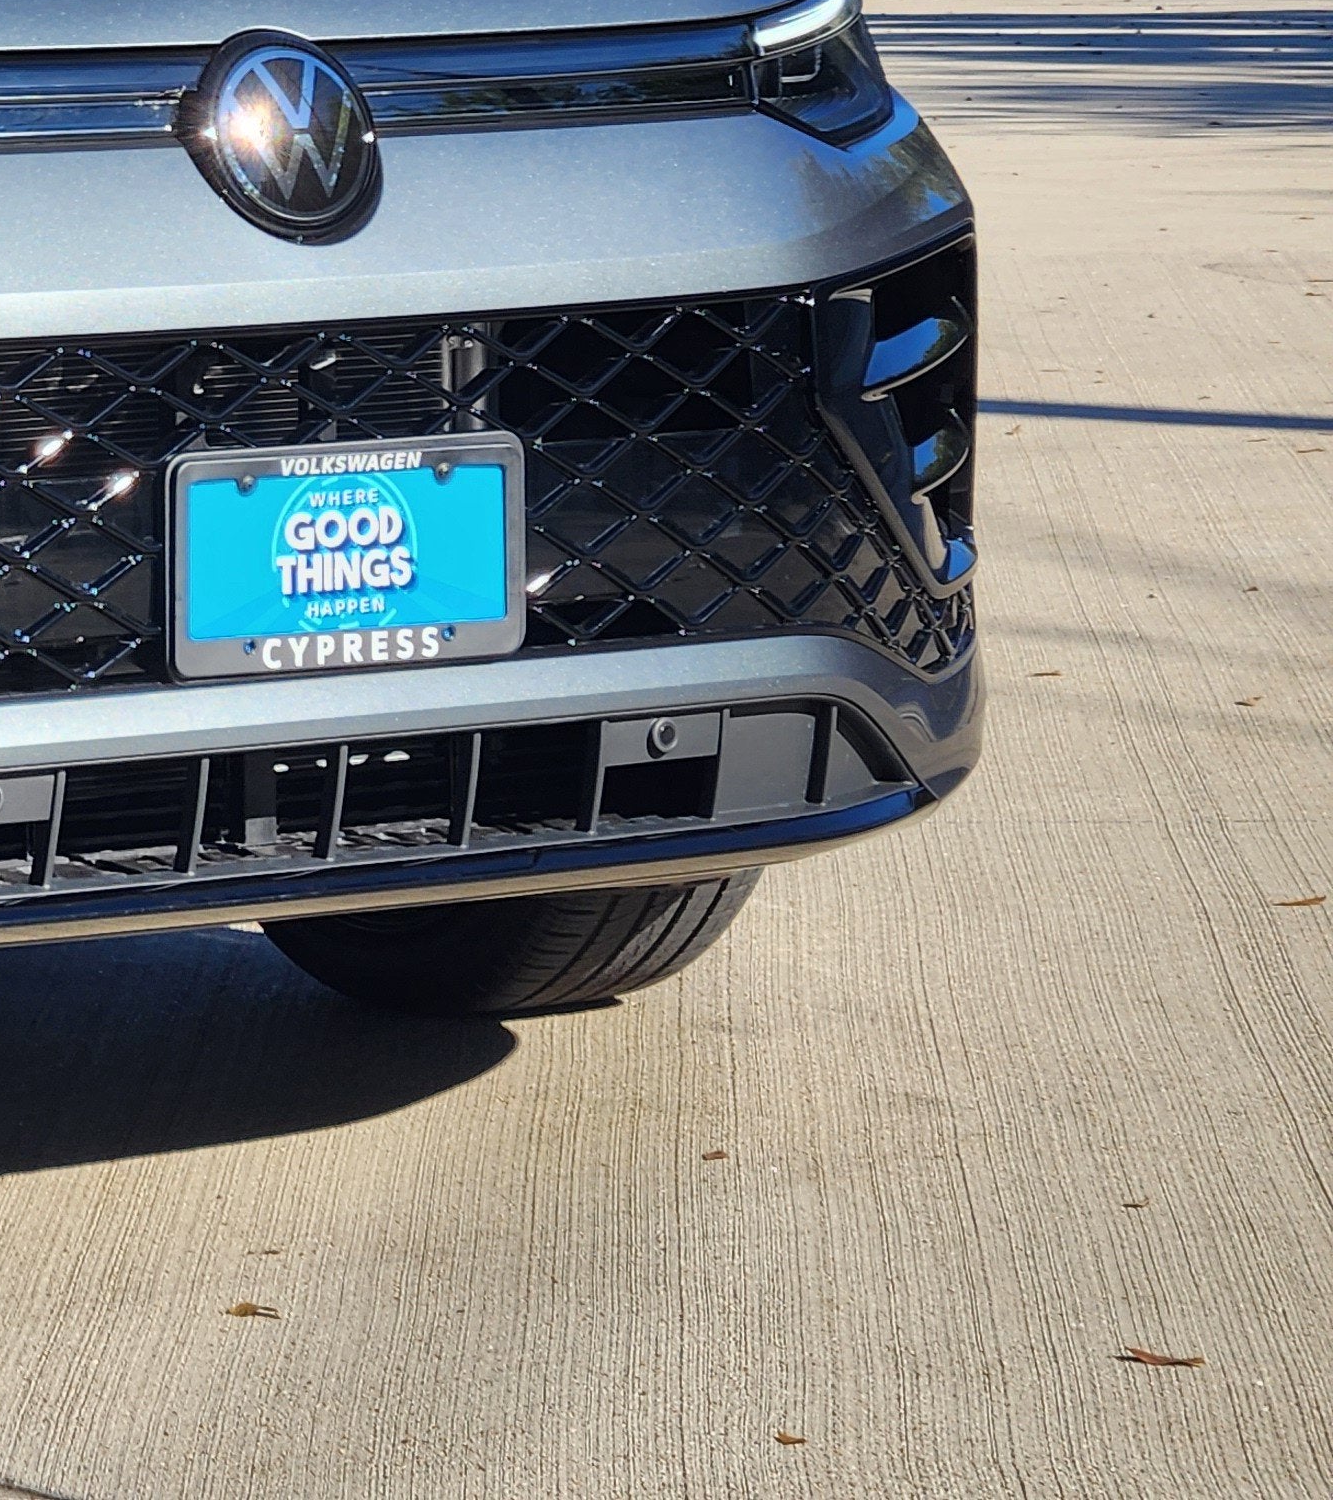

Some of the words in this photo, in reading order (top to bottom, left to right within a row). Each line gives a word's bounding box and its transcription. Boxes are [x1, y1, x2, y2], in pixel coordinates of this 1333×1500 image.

[280, 451, 422, 477] VOLKSWAGEN
[309, 488, 380, 508] WHERE
[284, 506, 403, 551] GOOD
[275, 546, 413, 596] THINGS
[307, 596, 386, 618] HAPPEN
[262, 626, 441, 670] CYPRESS
